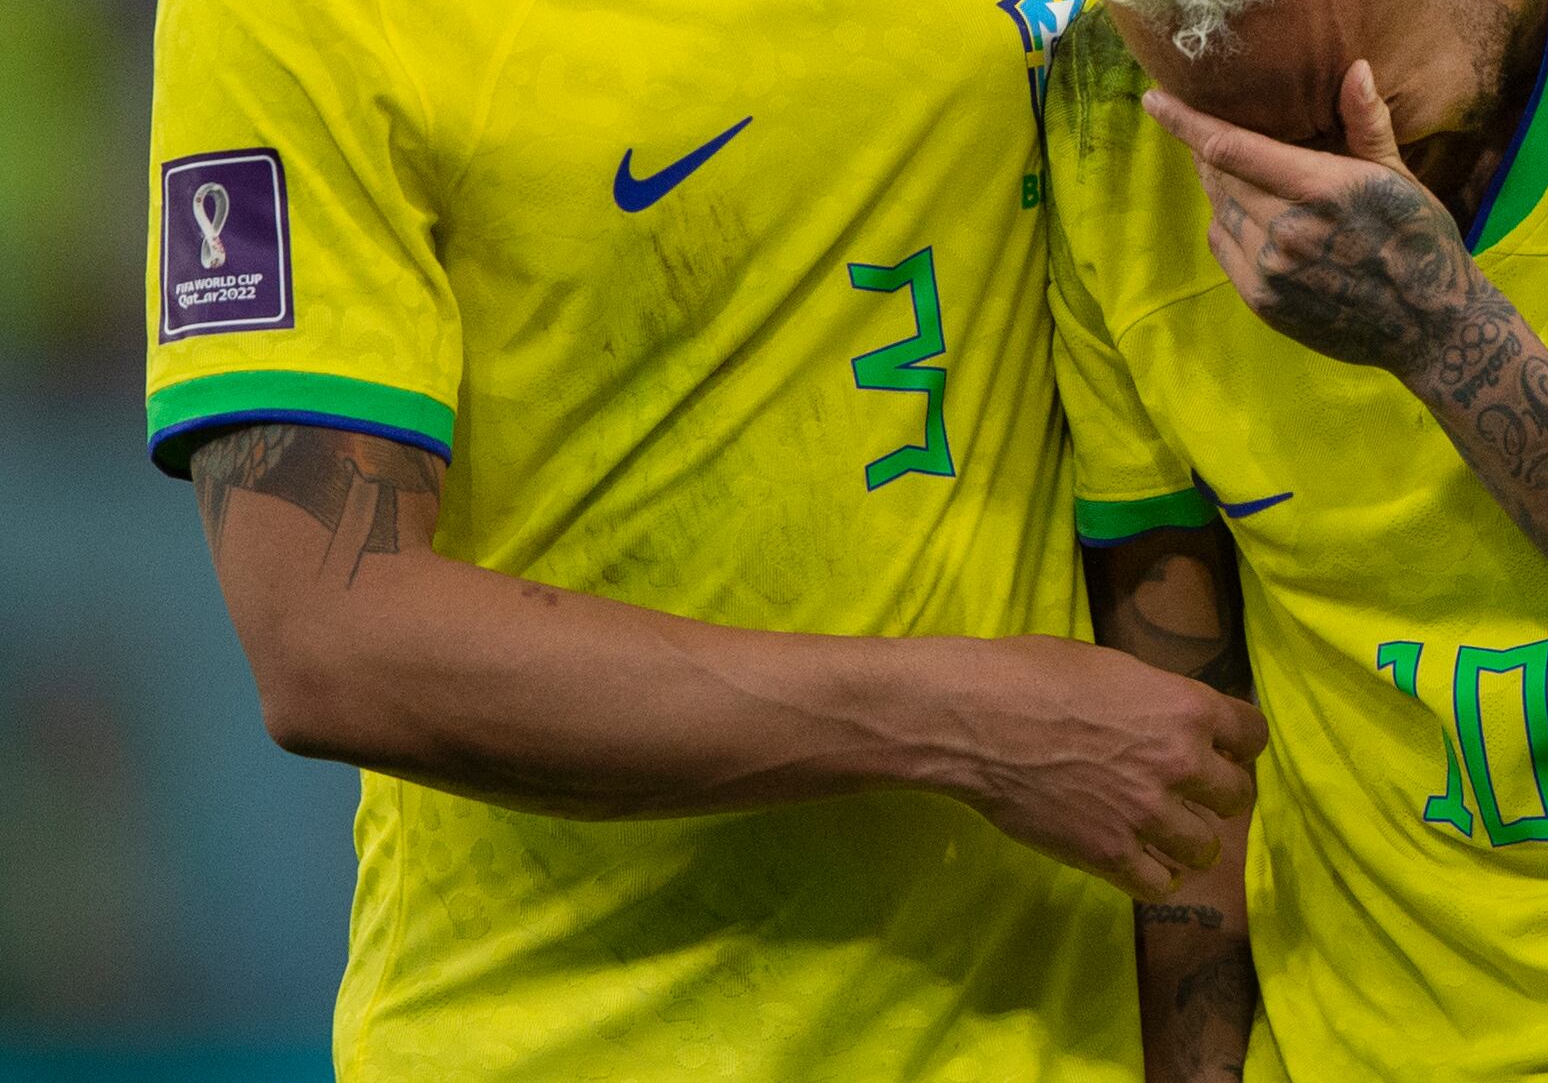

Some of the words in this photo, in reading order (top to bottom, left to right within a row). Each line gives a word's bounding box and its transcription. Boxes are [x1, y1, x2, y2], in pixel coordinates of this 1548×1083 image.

[176, 281, 195, 296] FIFA
[194, 275, 236, 293] WORLD
[237, 273, 263, 286] CUP
[847, 245, 956, 492] 3
